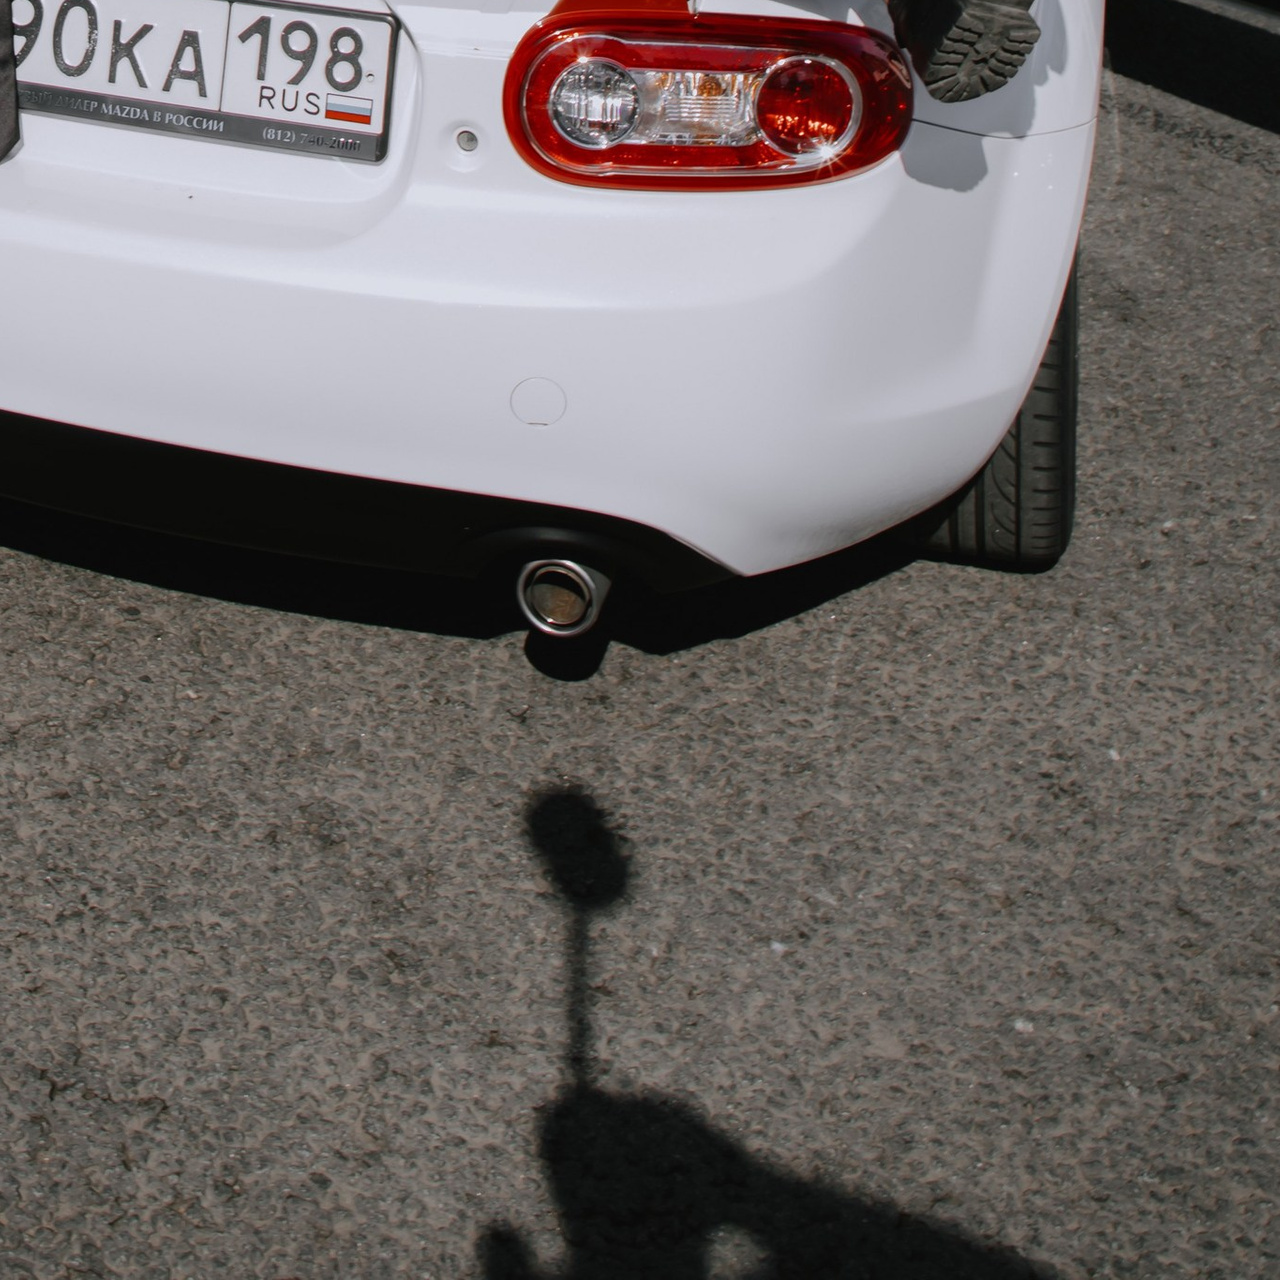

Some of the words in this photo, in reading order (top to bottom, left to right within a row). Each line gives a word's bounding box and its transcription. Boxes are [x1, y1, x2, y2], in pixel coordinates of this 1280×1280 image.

[238, 15, 363, 92] 198
[55, 96, 98, 112] ДИЛЕР
[101, 103, 149, 121] MAZDA
[165, 113, 224, 132] РОССИИ
[259, 85, 320, 116] RUS
[262, 126, 296, 145] (812)
